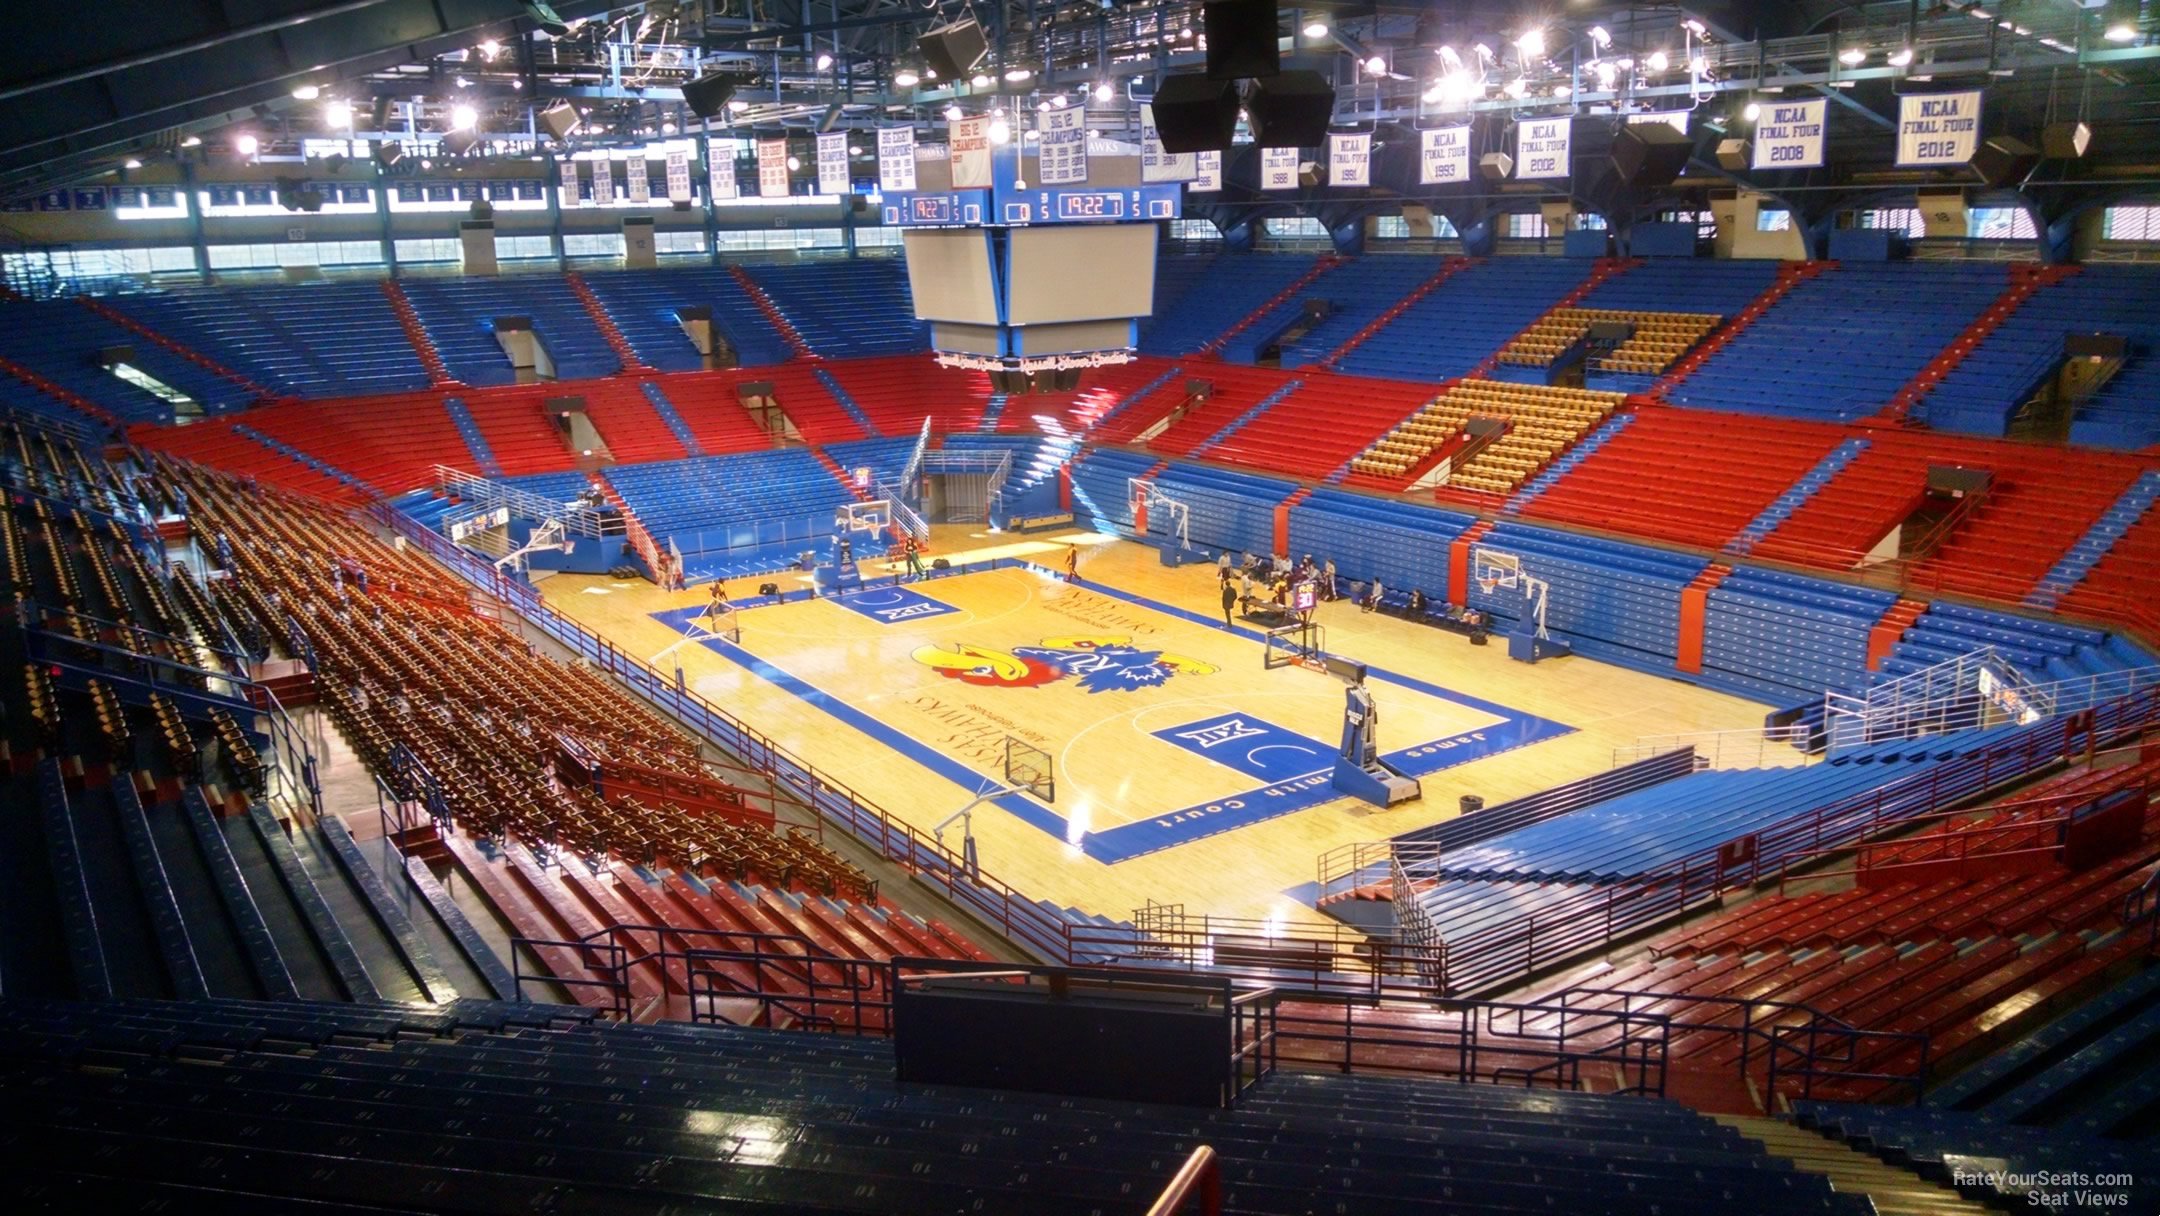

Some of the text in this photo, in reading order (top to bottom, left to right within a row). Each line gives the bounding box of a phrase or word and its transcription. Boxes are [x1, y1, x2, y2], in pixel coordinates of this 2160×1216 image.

[1774, 108, 1806, 123] NCAA
[1920, 100, 1958, 117] NCAA
[1050, 115, 1063, 128] BIG
[1903, 118, 1974, 134] FINAL FOUR
[1041, 127, 1083, 144] CHAMPIONS
[1531, 125, 1556, 139] NCAA
[1759, 124, 1821, 139] FINAL FOUR
[952, 137, 987, 152] CHAMPIONS
[1341, 140, 1360, 152] NCAA
[1434, 133, 1456, 147] NCAA
[1521, 139, 1566, 153] FINAL FOUR
[1087, 142, 1119, 153] AWKS
[1424, 146, 1466, 160] FINAL FOUR
[1771, 145, 1804, 161] 2008
[1918, 141, 1955, 158] 2012
[1435, 164, 1456, 177] 1993
[1530, 158, 1555, 172] 2002
[1067, 196, 1103, 214] 19:22
[1114, 201, 1118, 214] 1
[290, 229, 303, 239] 10
[1297, 593, 1314, 608] 30
[1155, 732, 1488, 828] James mith Court
